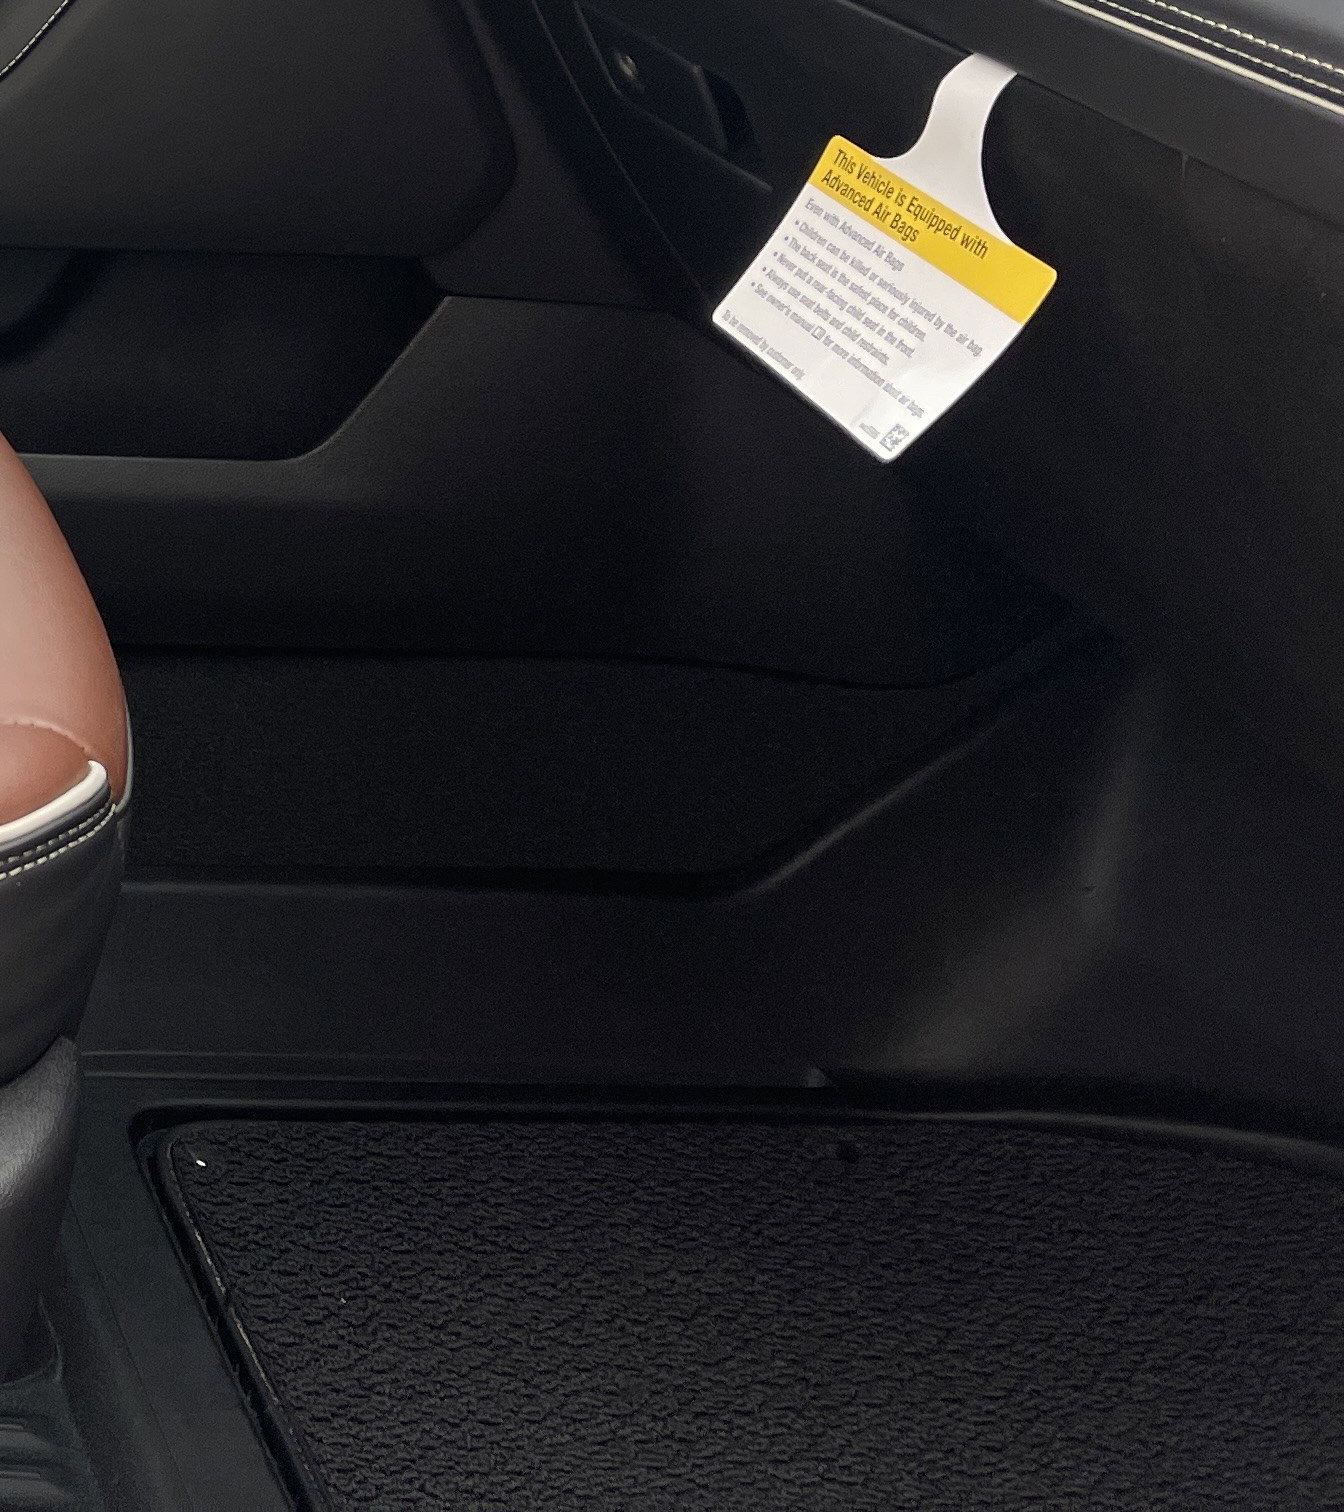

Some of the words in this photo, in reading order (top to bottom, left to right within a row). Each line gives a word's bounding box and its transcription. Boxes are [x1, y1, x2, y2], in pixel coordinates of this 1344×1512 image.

[820, 168, 875, 212] Advanced
[871, 202, 891, 223] Air
[888, 212, 919, 242] Bags
[833, 148, 856, 174] This
[856, 162, 894, 199] Vehicle
[893, 187, 906, 207] is
[905, 195, 962, 241] Equipped
[959, 232, 988, 259] with
